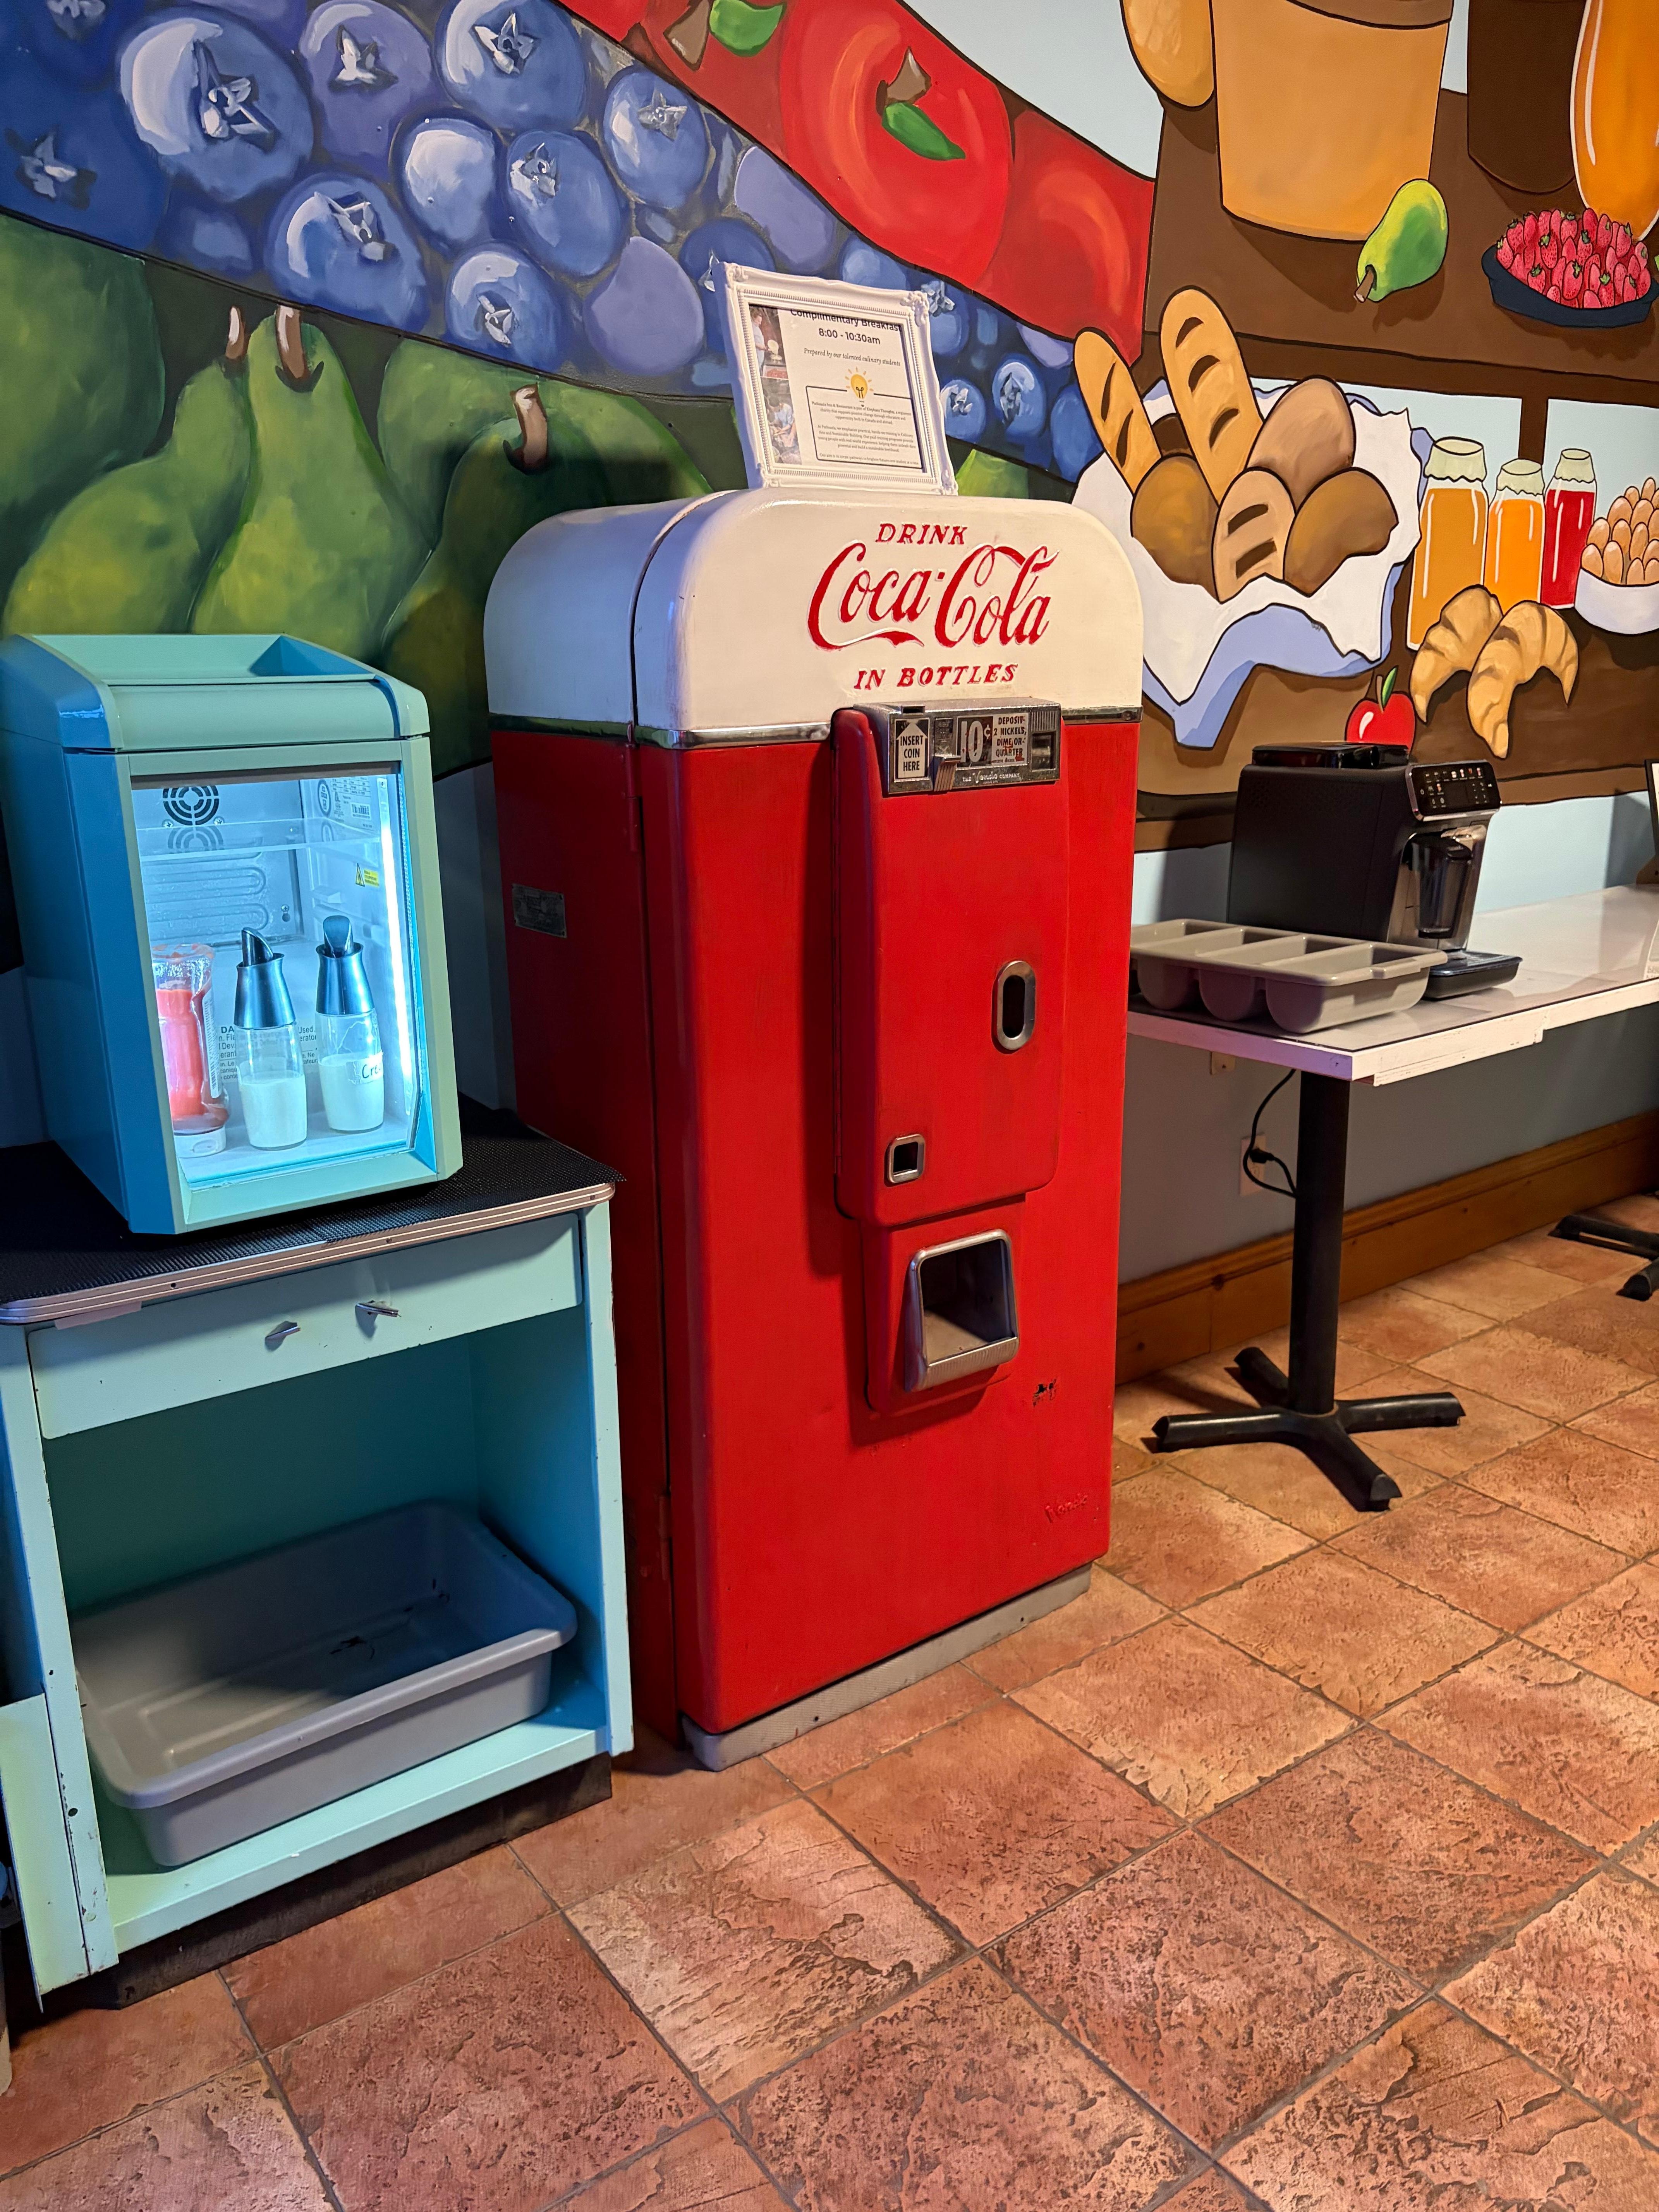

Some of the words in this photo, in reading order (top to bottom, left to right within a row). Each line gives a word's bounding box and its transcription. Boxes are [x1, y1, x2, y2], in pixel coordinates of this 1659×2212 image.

[819, 328, 838, 338] 8:00
[845, 332, 881, 345] 10:30am
[804, 348, 826, 356] Prepared
[827, 350, 832, 358] by
[862, 356, 881, 364] culinary
[875, 523, 967, 544] DRINK
[854, 669, 885, 690] IN
[897, 663, 1018, 687] BOTTLES
[998, 716, 1024, 725] DEPOSIT
[900, 735, 924, 746] INSERT
[904, 748, 920, 758] COIN
[996, 748, 1023, 757] QUARTER
[903, 761, 920, 771] HERE
